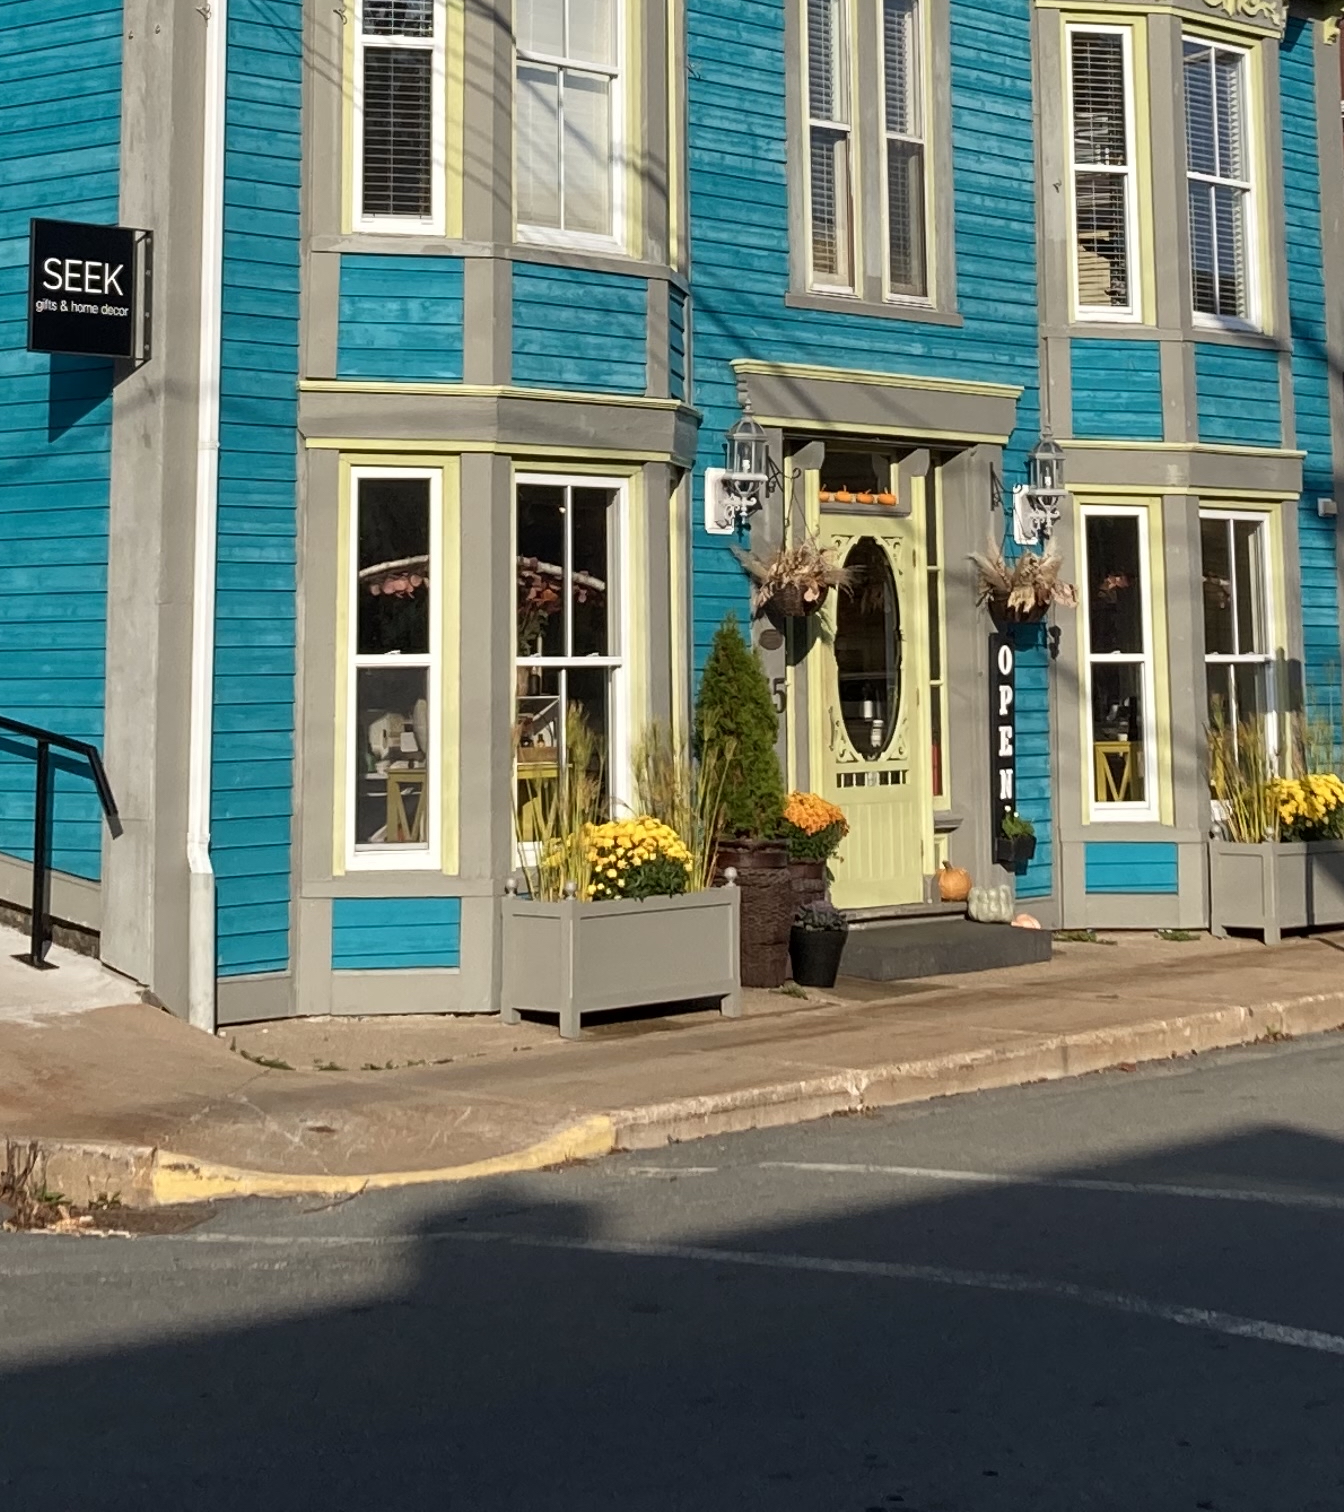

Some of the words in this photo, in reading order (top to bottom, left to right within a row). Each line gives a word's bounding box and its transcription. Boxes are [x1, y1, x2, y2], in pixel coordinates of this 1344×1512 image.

[42, 256, 124, 296] SEEK
[35, 298, 58, 313] gifts
[60, 300, 69, 312] &
[71, 300, 99, 315] home
[100, 303, 130, 317] decor
[998, 644, 1013, 800] OPEN
